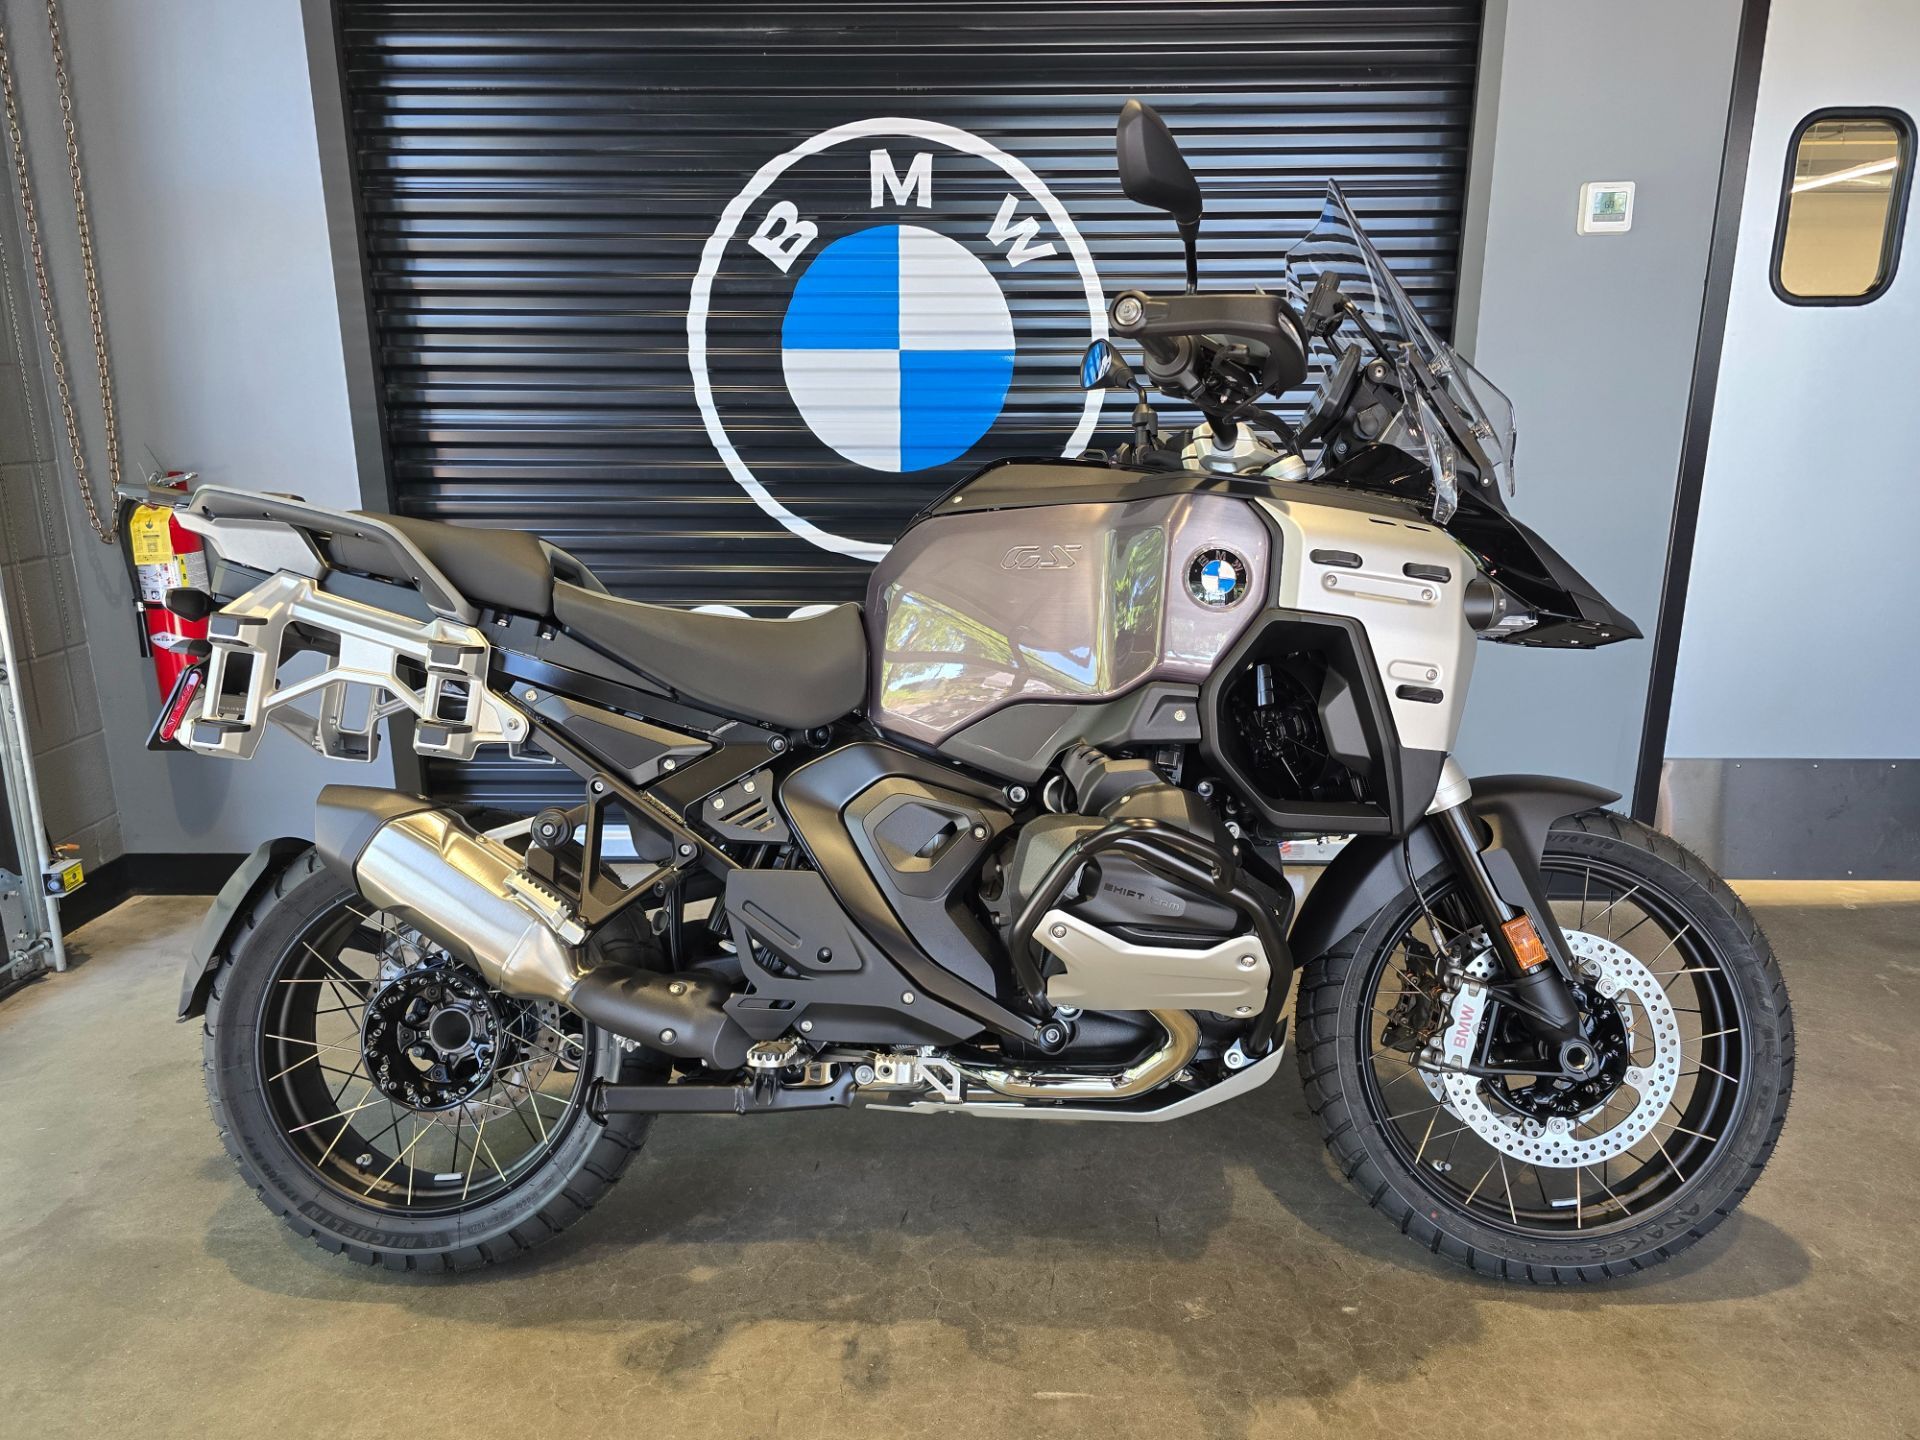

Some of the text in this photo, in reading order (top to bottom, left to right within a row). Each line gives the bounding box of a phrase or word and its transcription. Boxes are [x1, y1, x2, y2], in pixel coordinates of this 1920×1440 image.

[748, 148, 1057, 273] BMW
[1000, 544, 1083, 570] GS
[1196, 549, 1244, 572] BMW
[1103, 882, 1145, 901] SHIFT
[1453, 1004, 1475, 1049] BMW
[304, 1204, 420, 1249] MICHELIN
[1589, 1202, 1700, 1258] ANAKEE
